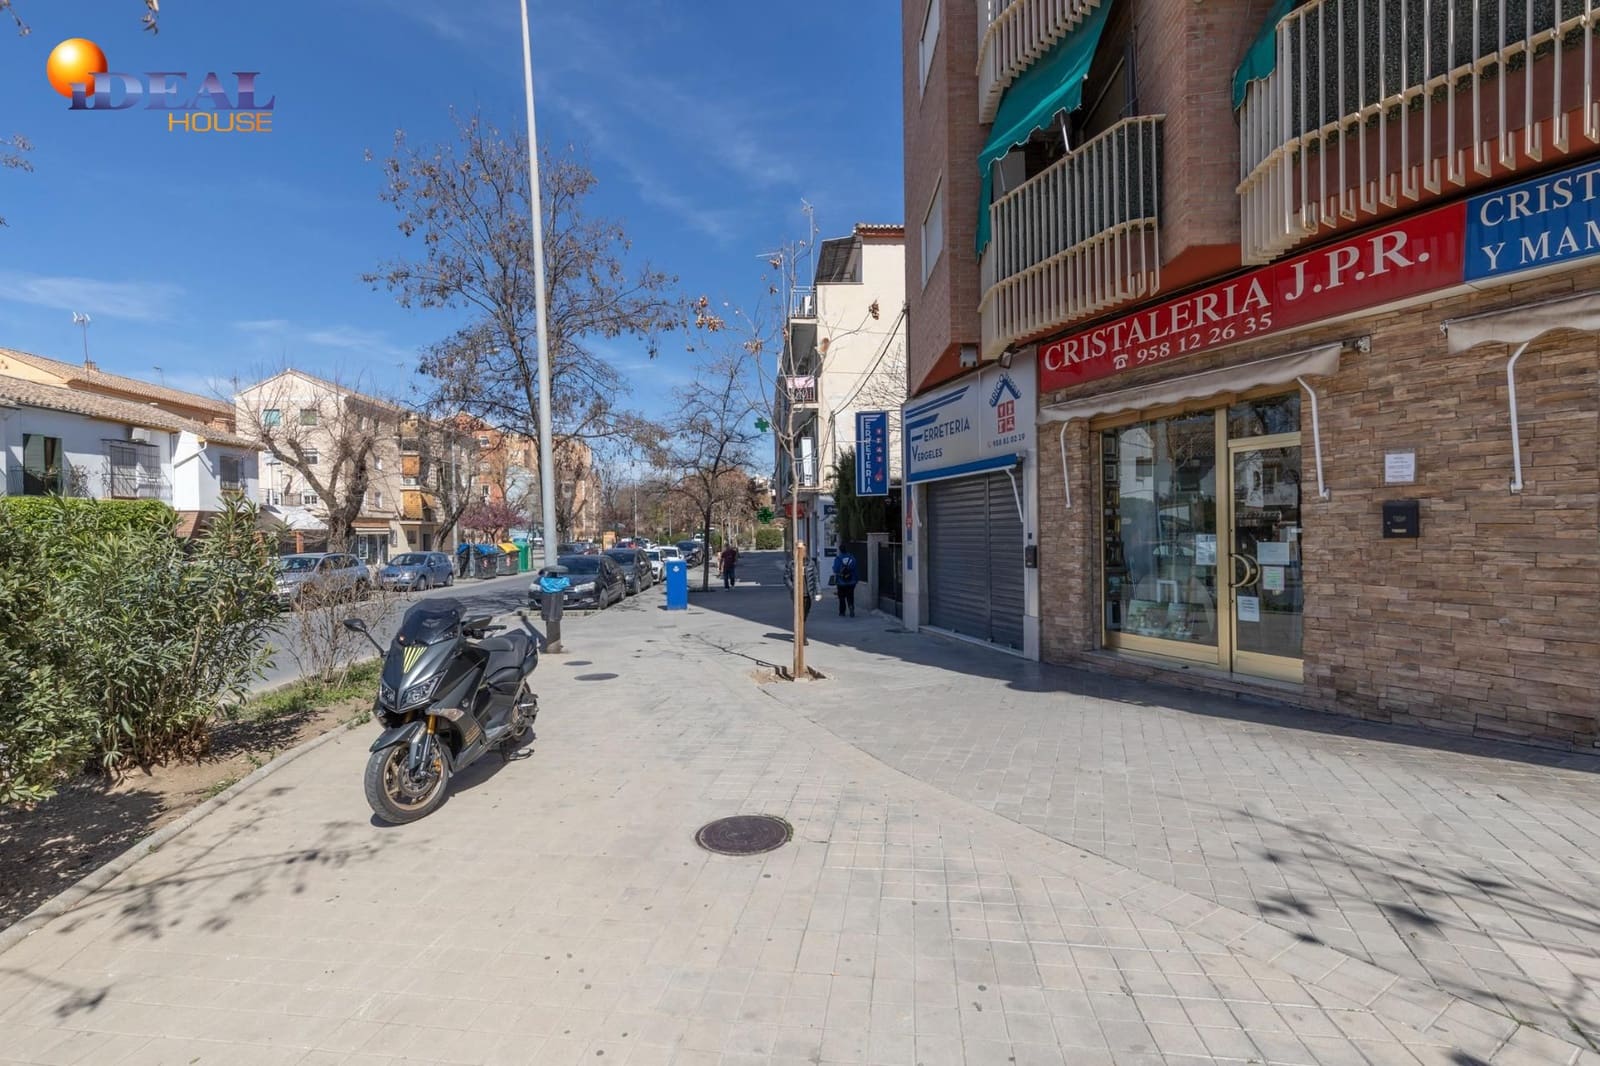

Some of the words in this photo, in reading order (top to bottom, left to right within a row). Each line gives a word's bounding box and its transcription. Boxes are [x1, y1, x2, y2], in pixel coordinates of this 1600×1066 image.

[1480, 169, 1600, 227] CRIST
[1481, 242, 1506, 271] Y
[1044, 277, 1272, 371] CRISTALERIA
[1285, 230, 1430, 301] J.P.R.
[1136, 342, 1171, 365] 958
[1179, 333, 1201, 352] 12
[1208, 323, 1236, 345] 26
[1243, 312, 1272, 335] 35
